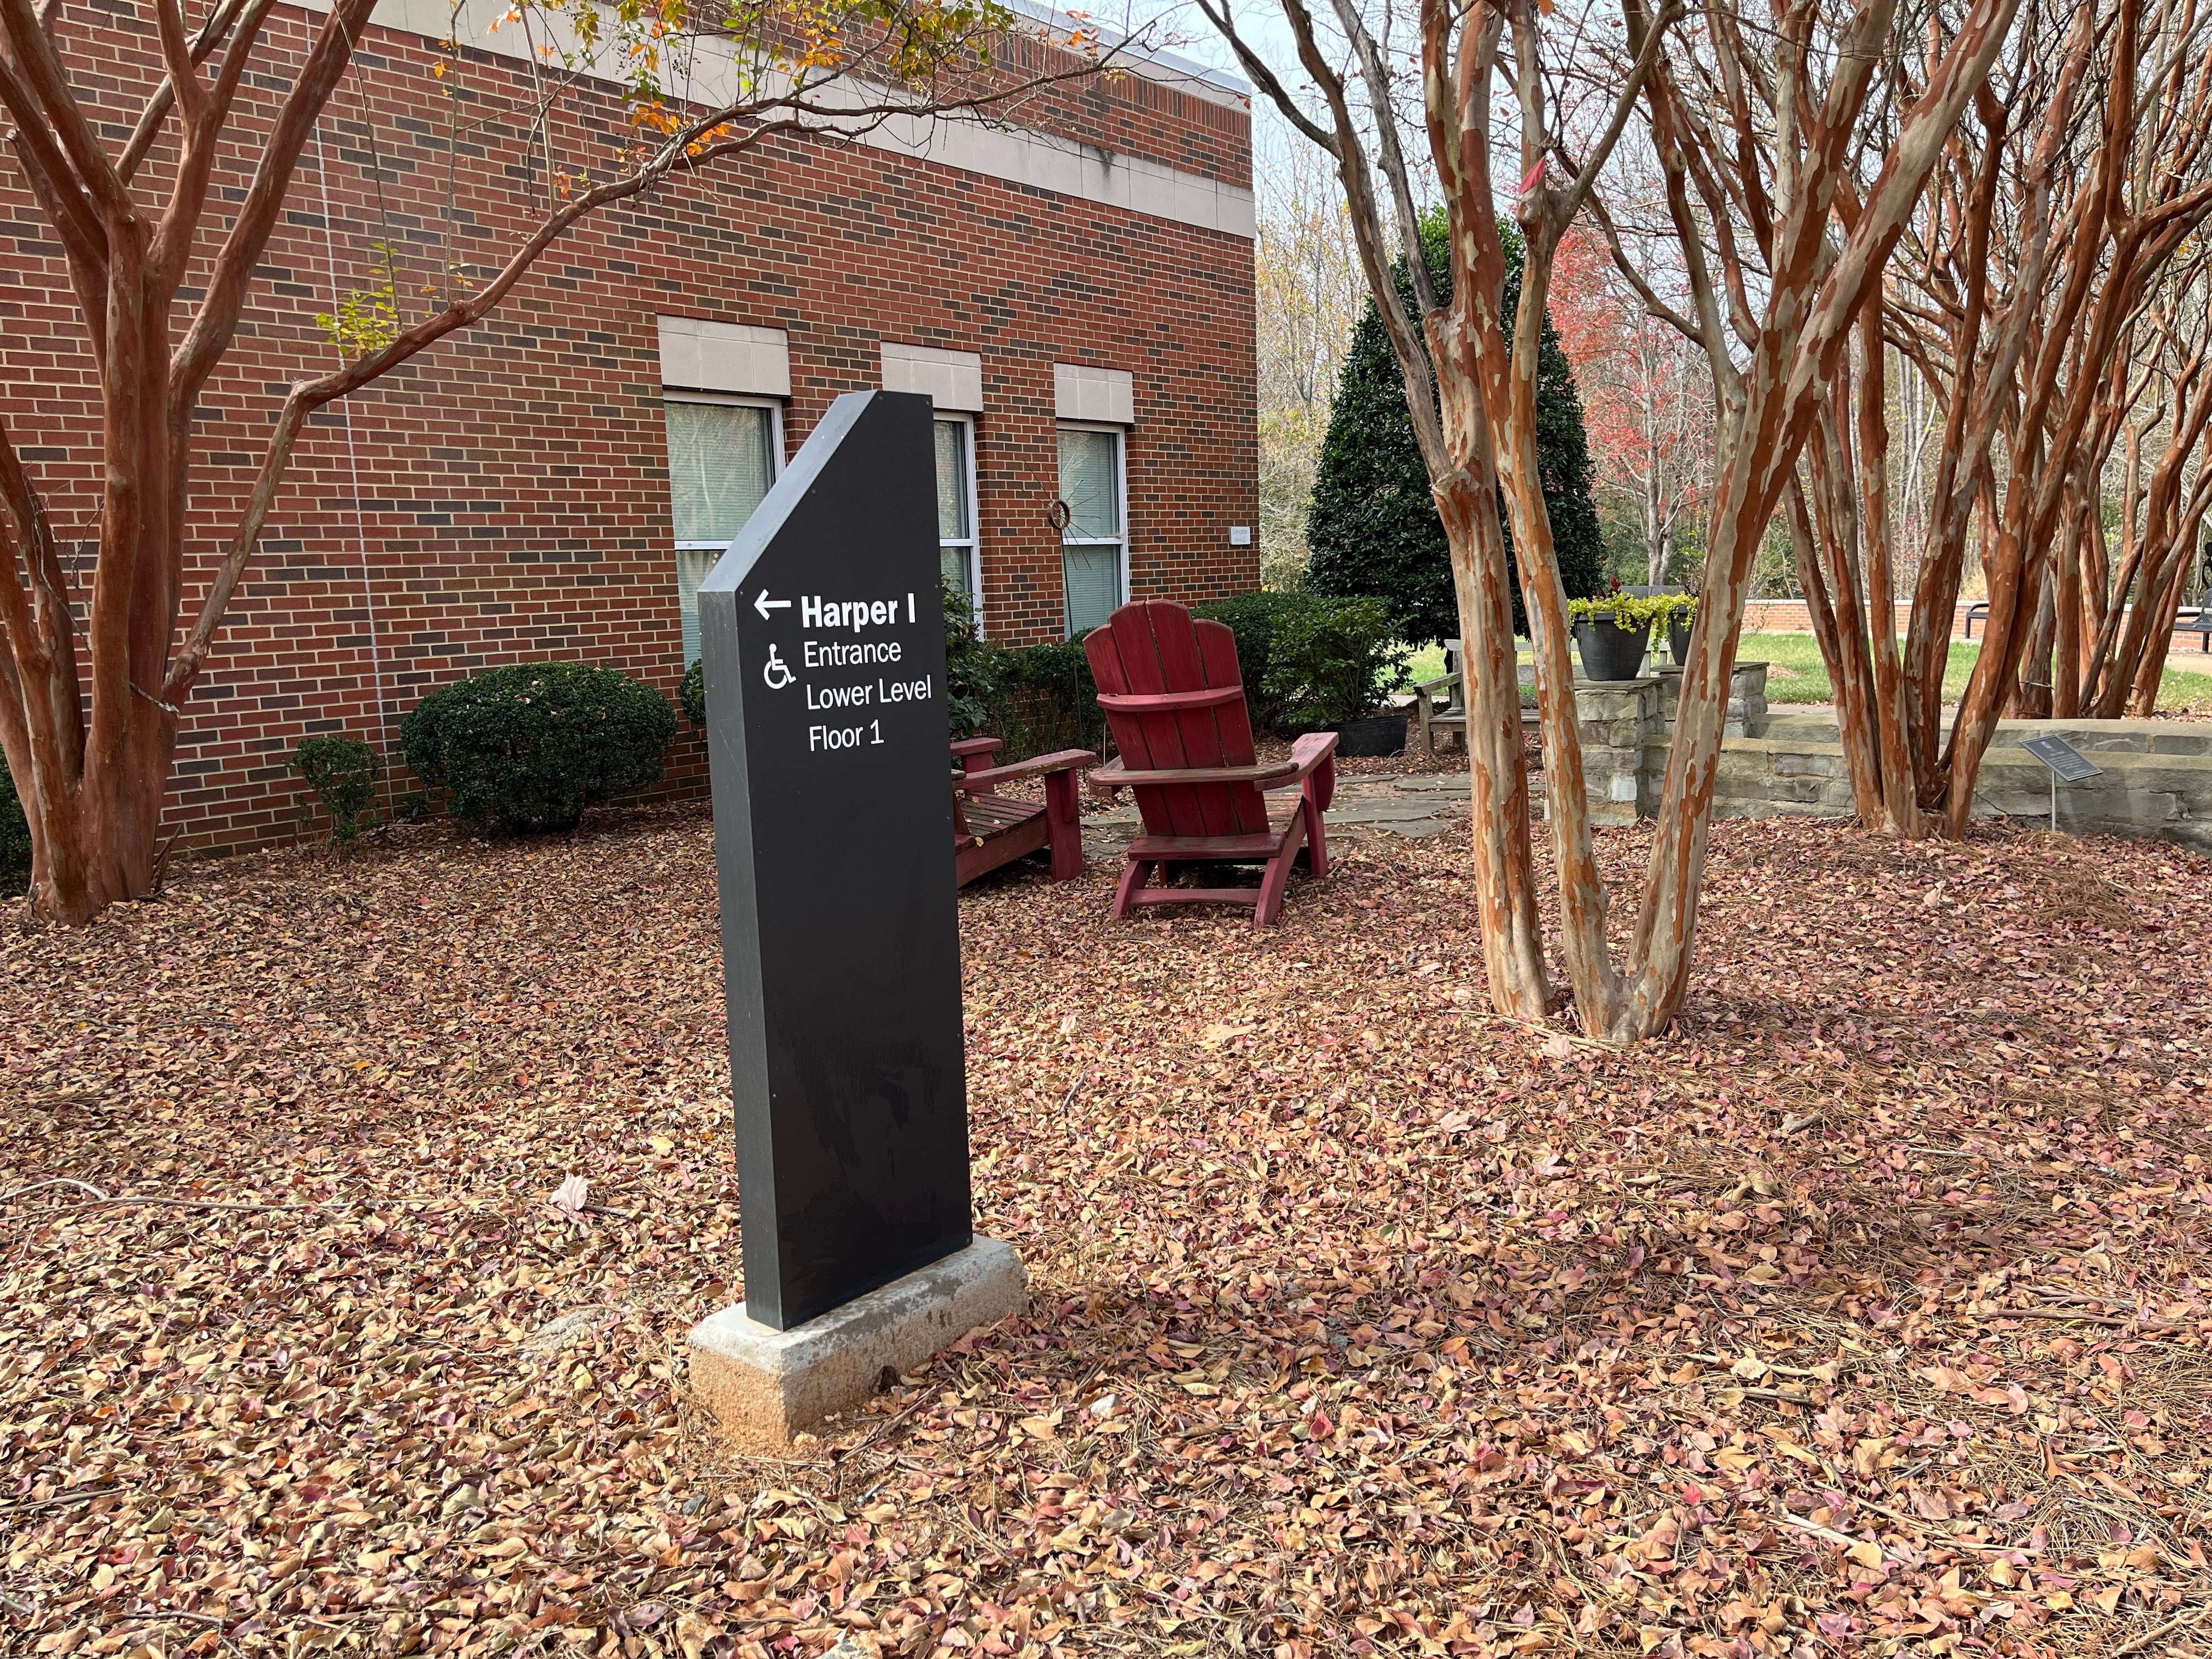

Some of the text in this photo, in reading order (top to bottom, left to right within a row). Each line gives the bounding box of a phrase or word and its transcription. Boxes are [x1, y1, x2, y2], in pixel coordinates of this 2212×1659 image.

[801, 592, 916, 633] Harper I
[804, 641, 901, 668] Entrance
[806, 674, 932, 710] Lower Level
[809, 719, 884, 752] Floor 1
